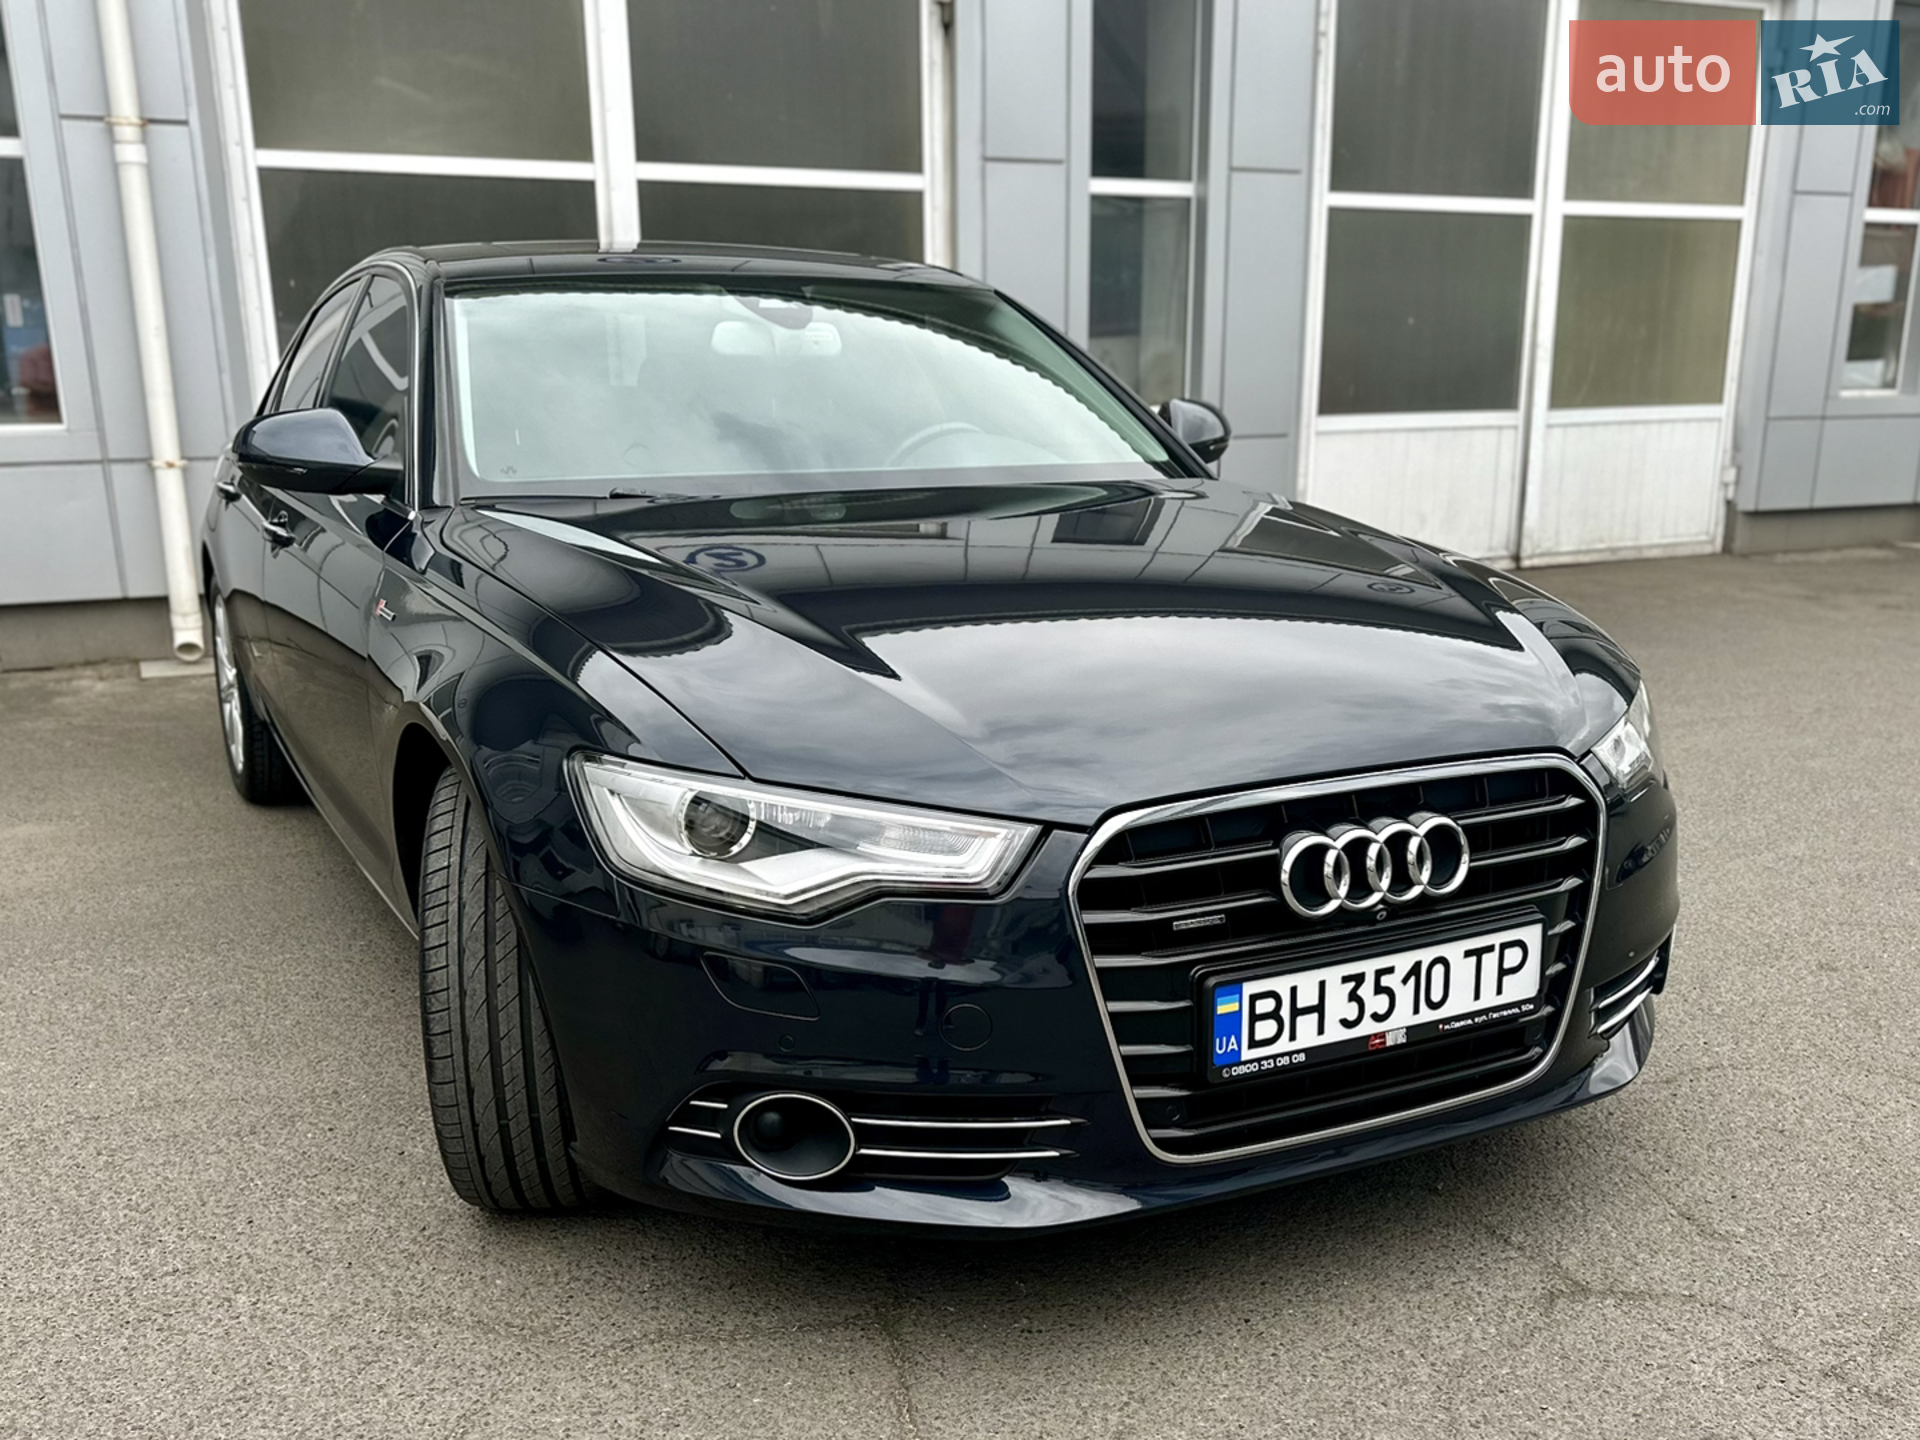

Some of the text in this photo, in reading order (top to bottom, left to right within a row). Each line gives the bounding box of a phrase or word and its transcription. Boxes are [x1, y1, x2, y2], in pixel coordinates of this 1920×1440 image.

[1247, 938, 1529, 1050] BH 3510 TP
[1215, 1034, 1239, 1054] UA
[1231, 1052, 1306, 1076] 0800 33 08 08
